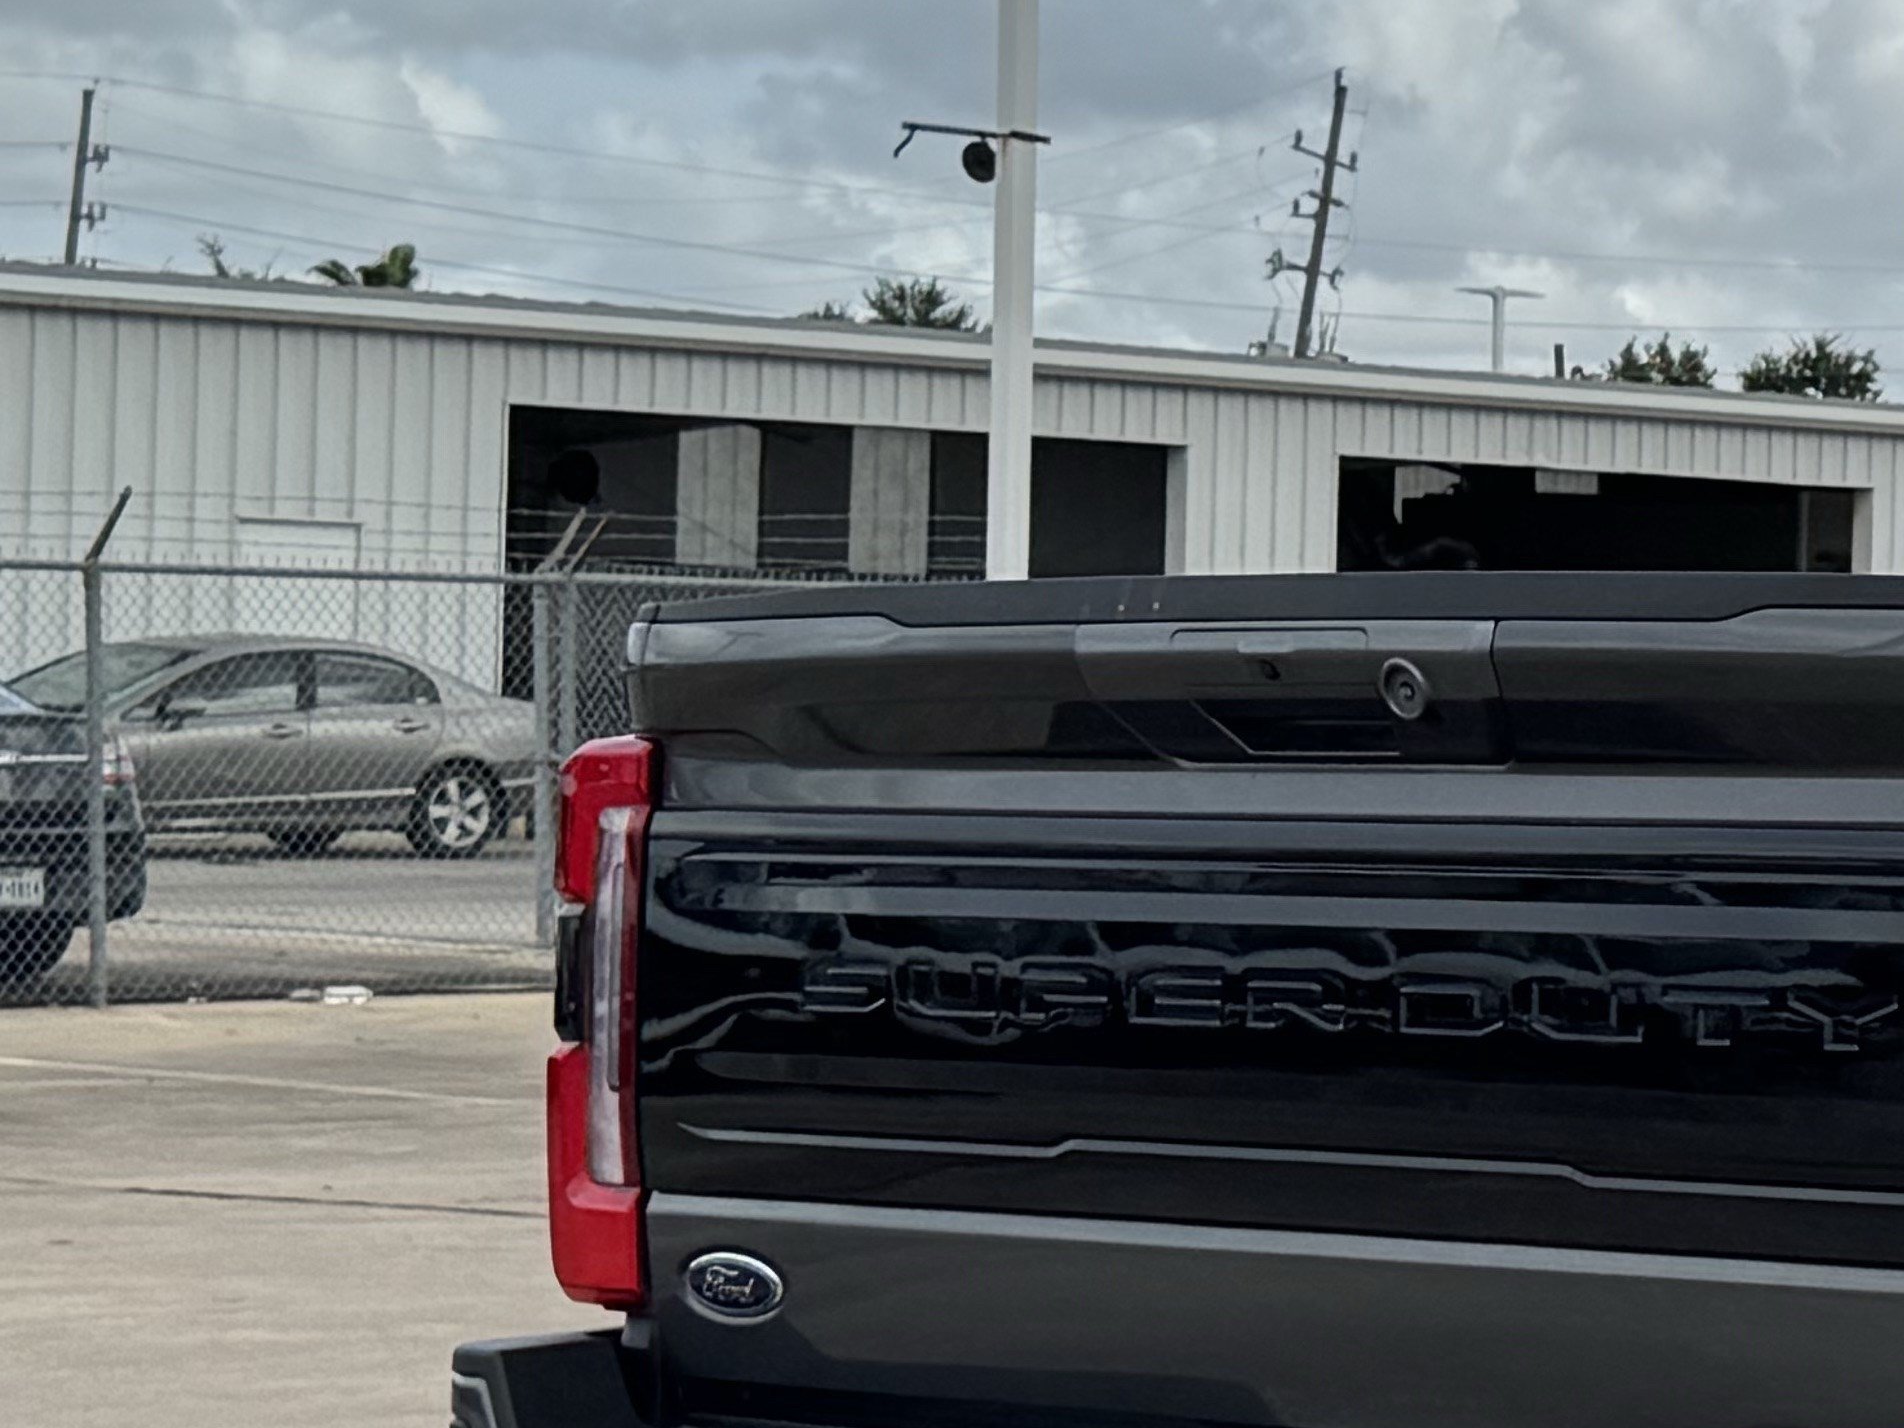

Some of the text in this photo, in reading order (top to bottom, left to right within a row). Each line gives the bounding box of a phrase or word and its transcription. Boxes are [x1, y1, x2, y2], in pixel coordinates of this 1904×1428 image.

[802, 957, 1899, 1052] SUPER DUTY
[702, 1265, 755, 1303] Ford
